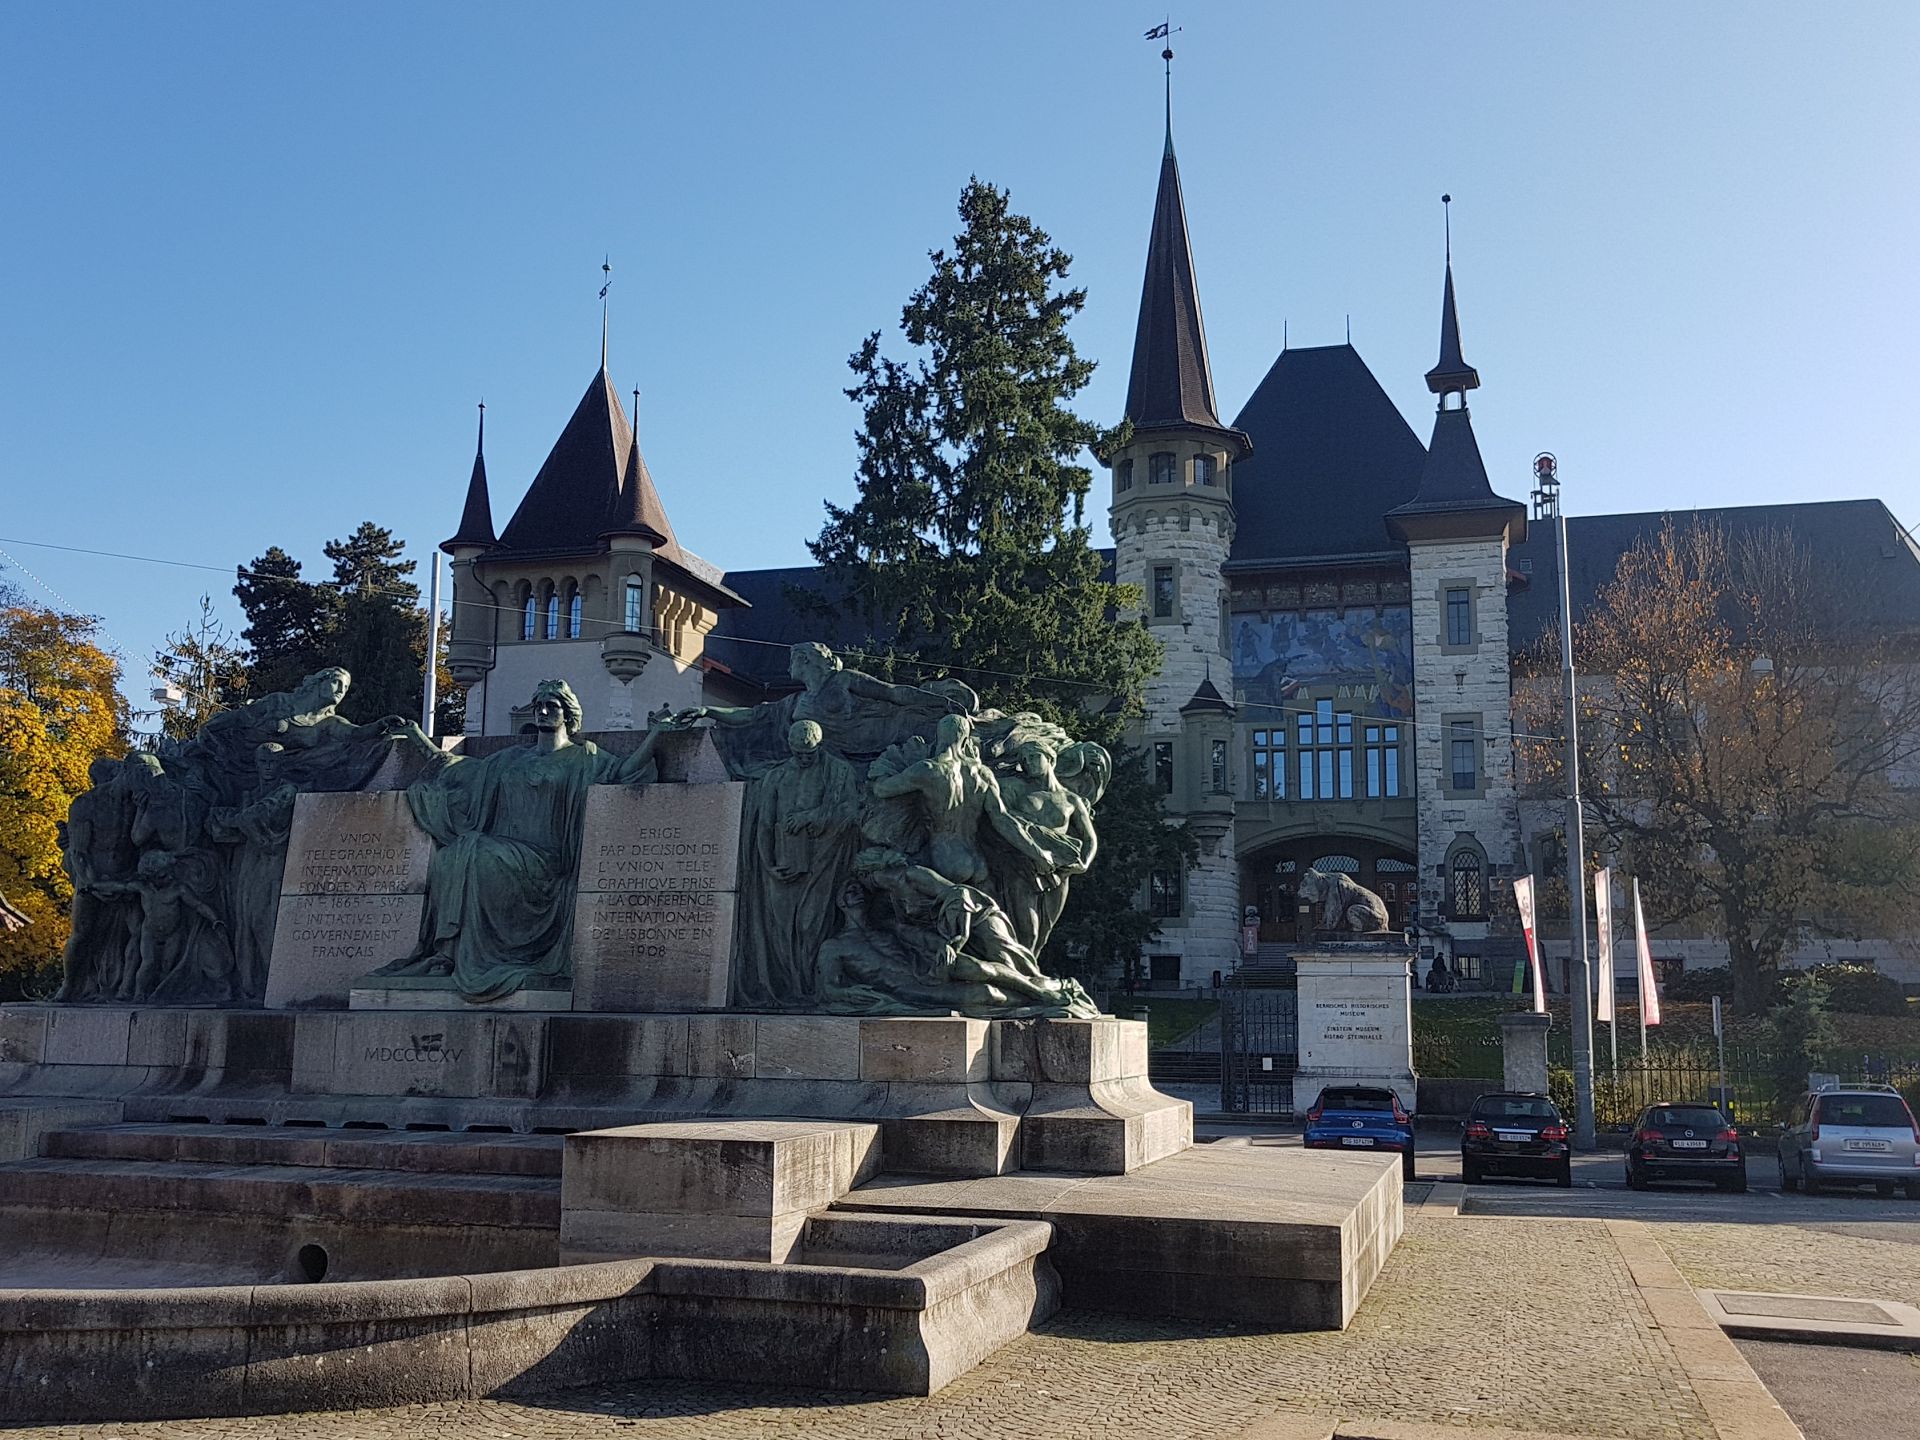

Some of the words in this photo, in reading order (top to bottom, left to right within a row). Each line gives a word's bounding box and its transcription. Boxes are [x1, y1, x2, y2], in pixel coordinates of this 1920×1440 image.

[340, 832, 382, 844] VNION
[640, 827, 681, 840] ERIGE
[600, 845, 625, 857] PAR
[631, 844, 697, 856] DECISION
[702, 843, 720, 855] DE
[302, 864, 410, 877] INTERNATIONALE
[374, 880, 409, 893] PARIS
[597, 877, 678, 890] GRAPHIQVE
[682, 877, 717, 890] PRISE
[332, 897, 361, 909] 1865
[628, 894, 715, 907] CONFERENCE
[294, 913, 376, 925] LINITIATIVE
[593, 911, 714, 924] INTERNATIONALE
[292, 929, 401, 942] GOVVERNEMENT
[592, 929, 610, 940] DE
[618, 928, 685, 940] LISBONNE
[692, 928, 713, 940] EN
[631, 945, 667, 957] 1908
[364, 1047, 465, 1063] MDCCCCXV
